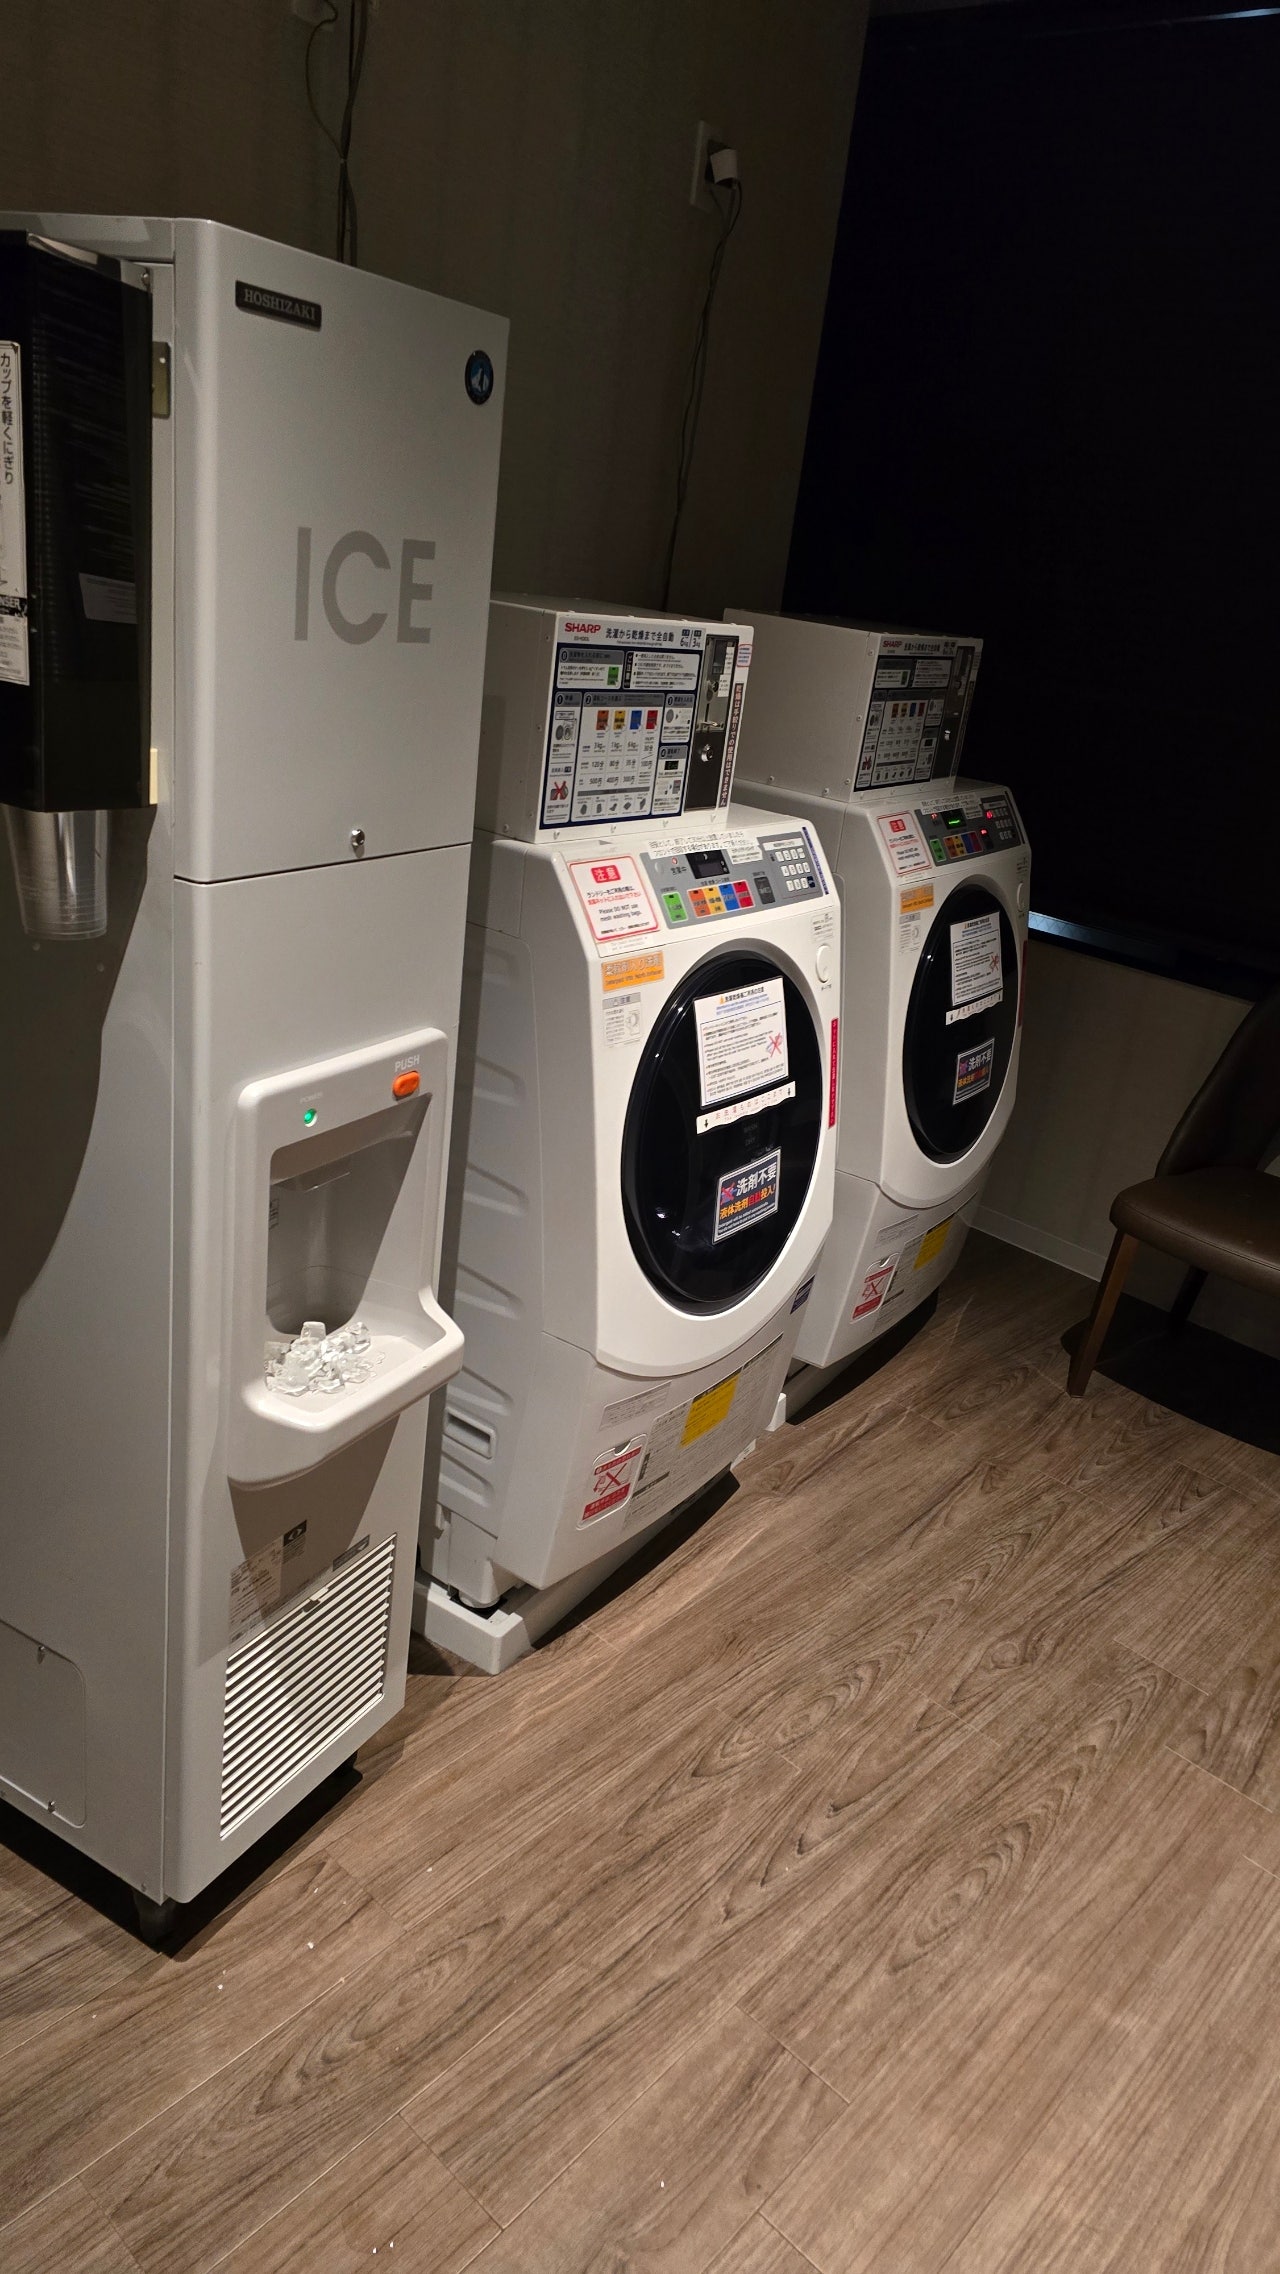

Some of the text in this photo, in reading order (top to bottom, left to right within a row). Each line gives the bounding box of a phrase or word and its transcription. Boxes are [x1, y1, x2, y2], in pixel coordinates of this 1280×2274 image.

[244, 288, 317, 321] HOSHIZAKI
[294, 527, 436, 645] ICE
[565, 622, 601, 634] SHARP
[605, 627, 675, 642] 洗濯から乾燥まで全自動
[882, 640, 902, 648] SHARP
[594, 867, 618, 881] 注意
[394, 1055, 420, 1073] PUSH
[736, 1162, 777, 1196] 洗剤不要
